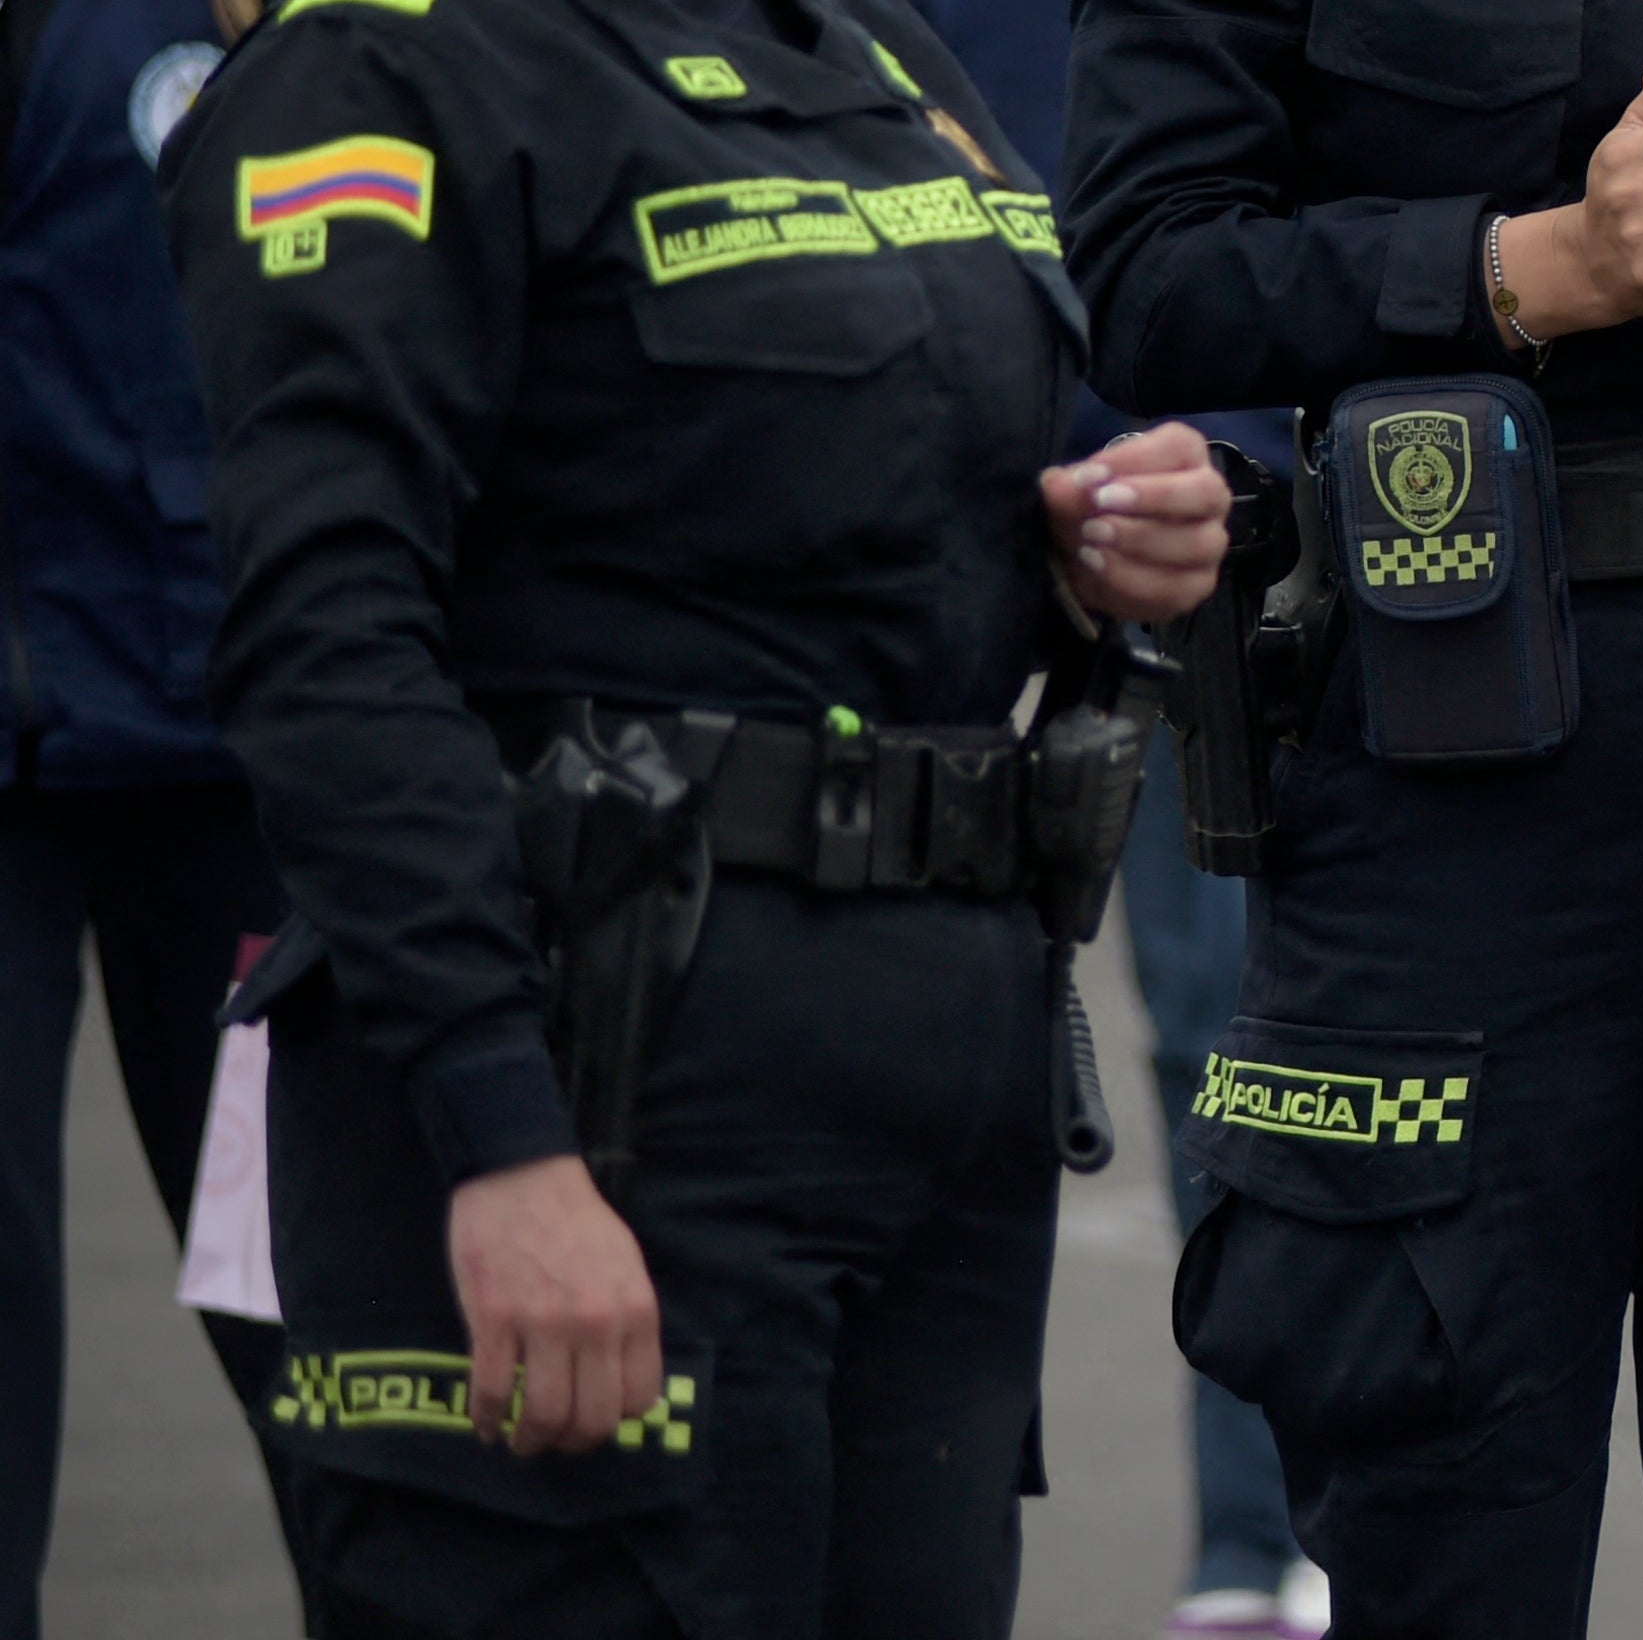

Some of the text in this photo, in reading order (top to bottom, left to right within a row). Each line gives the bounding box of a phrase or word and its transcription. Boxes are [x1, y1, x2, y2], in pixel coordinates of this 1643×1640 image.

[1376, 432, 1463, 455] NACIONAL
[1230, 1082, 1358, 1130] POLICÍA
[348, 1374, 468, 1417] POLI
